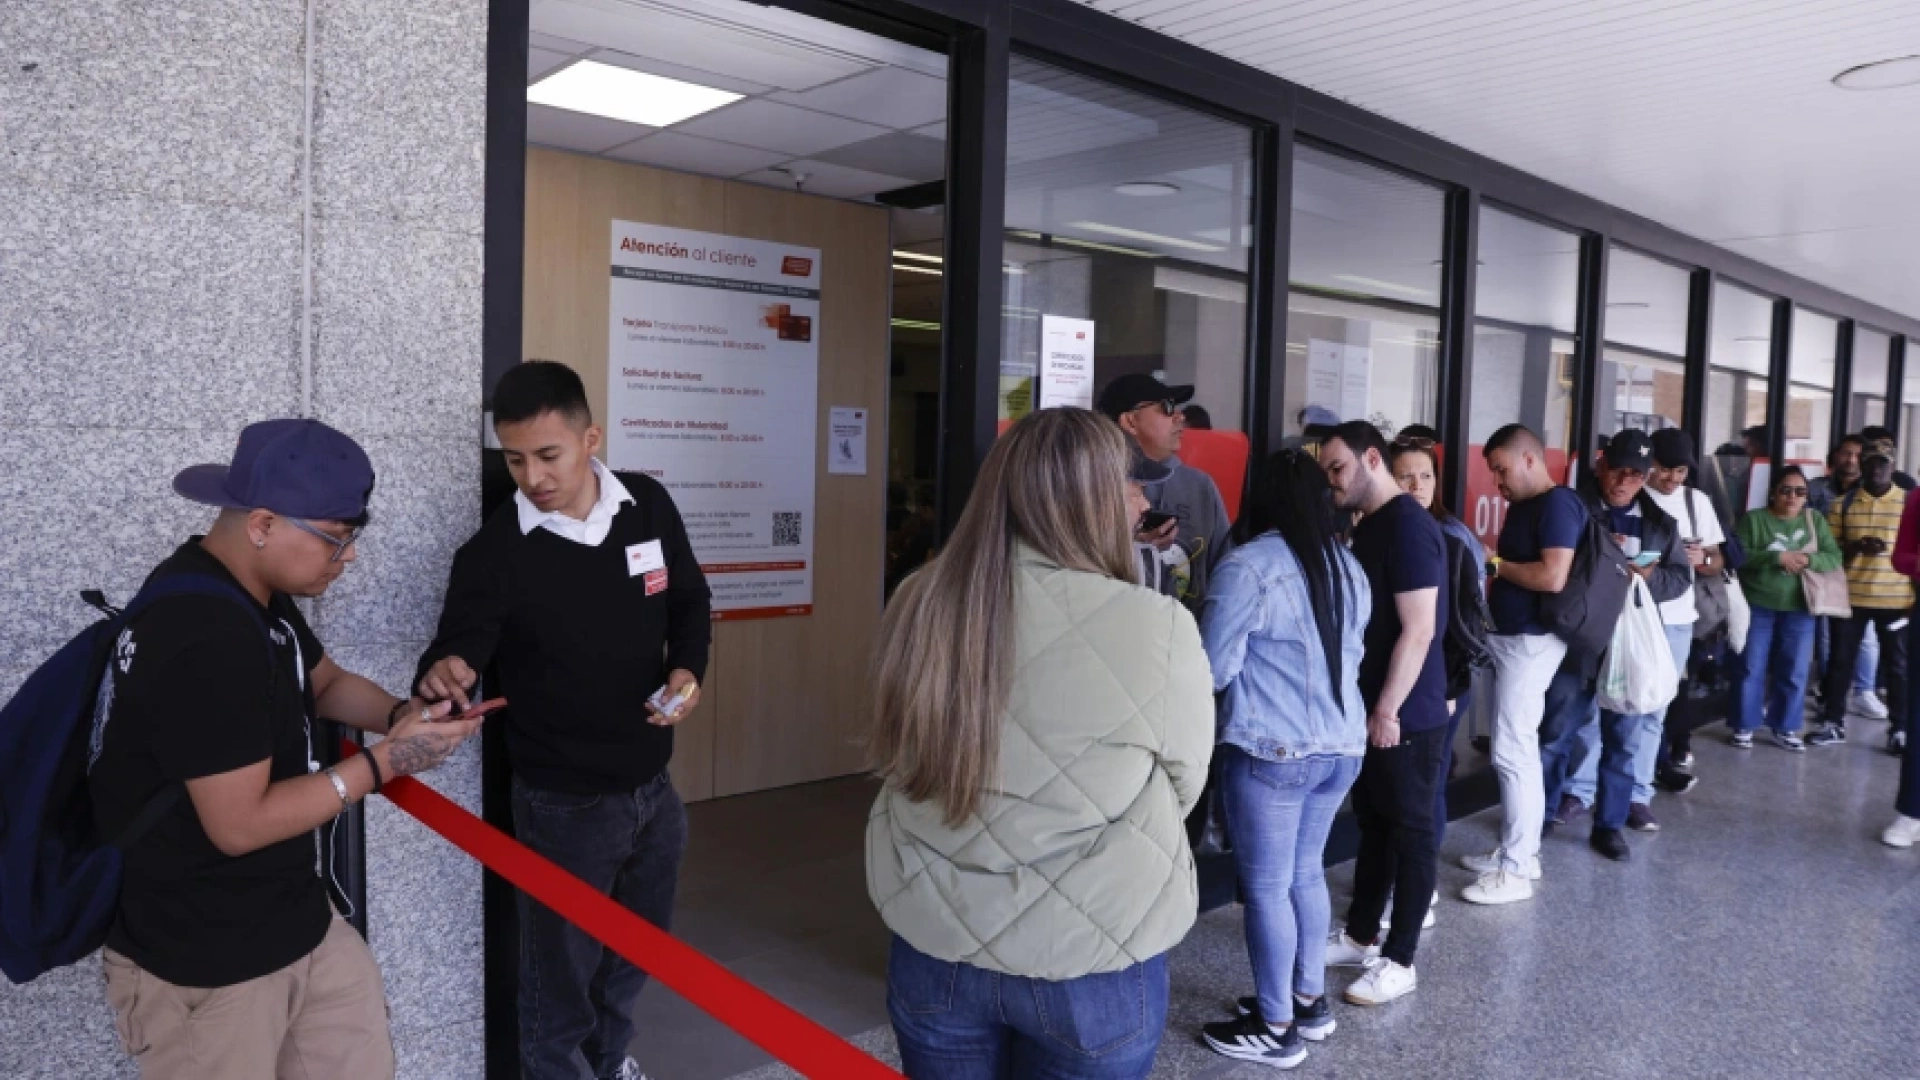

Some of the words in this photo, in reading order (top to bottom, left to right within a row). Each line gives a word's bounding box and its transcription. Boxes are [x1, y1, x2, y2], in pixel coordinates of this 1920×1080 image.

[620, 236, 688, 259] Atención
[691, 247, 706, 261] al
[709, 250, 758, 268] cliente
[1475, 495, 1509, 536] 01
